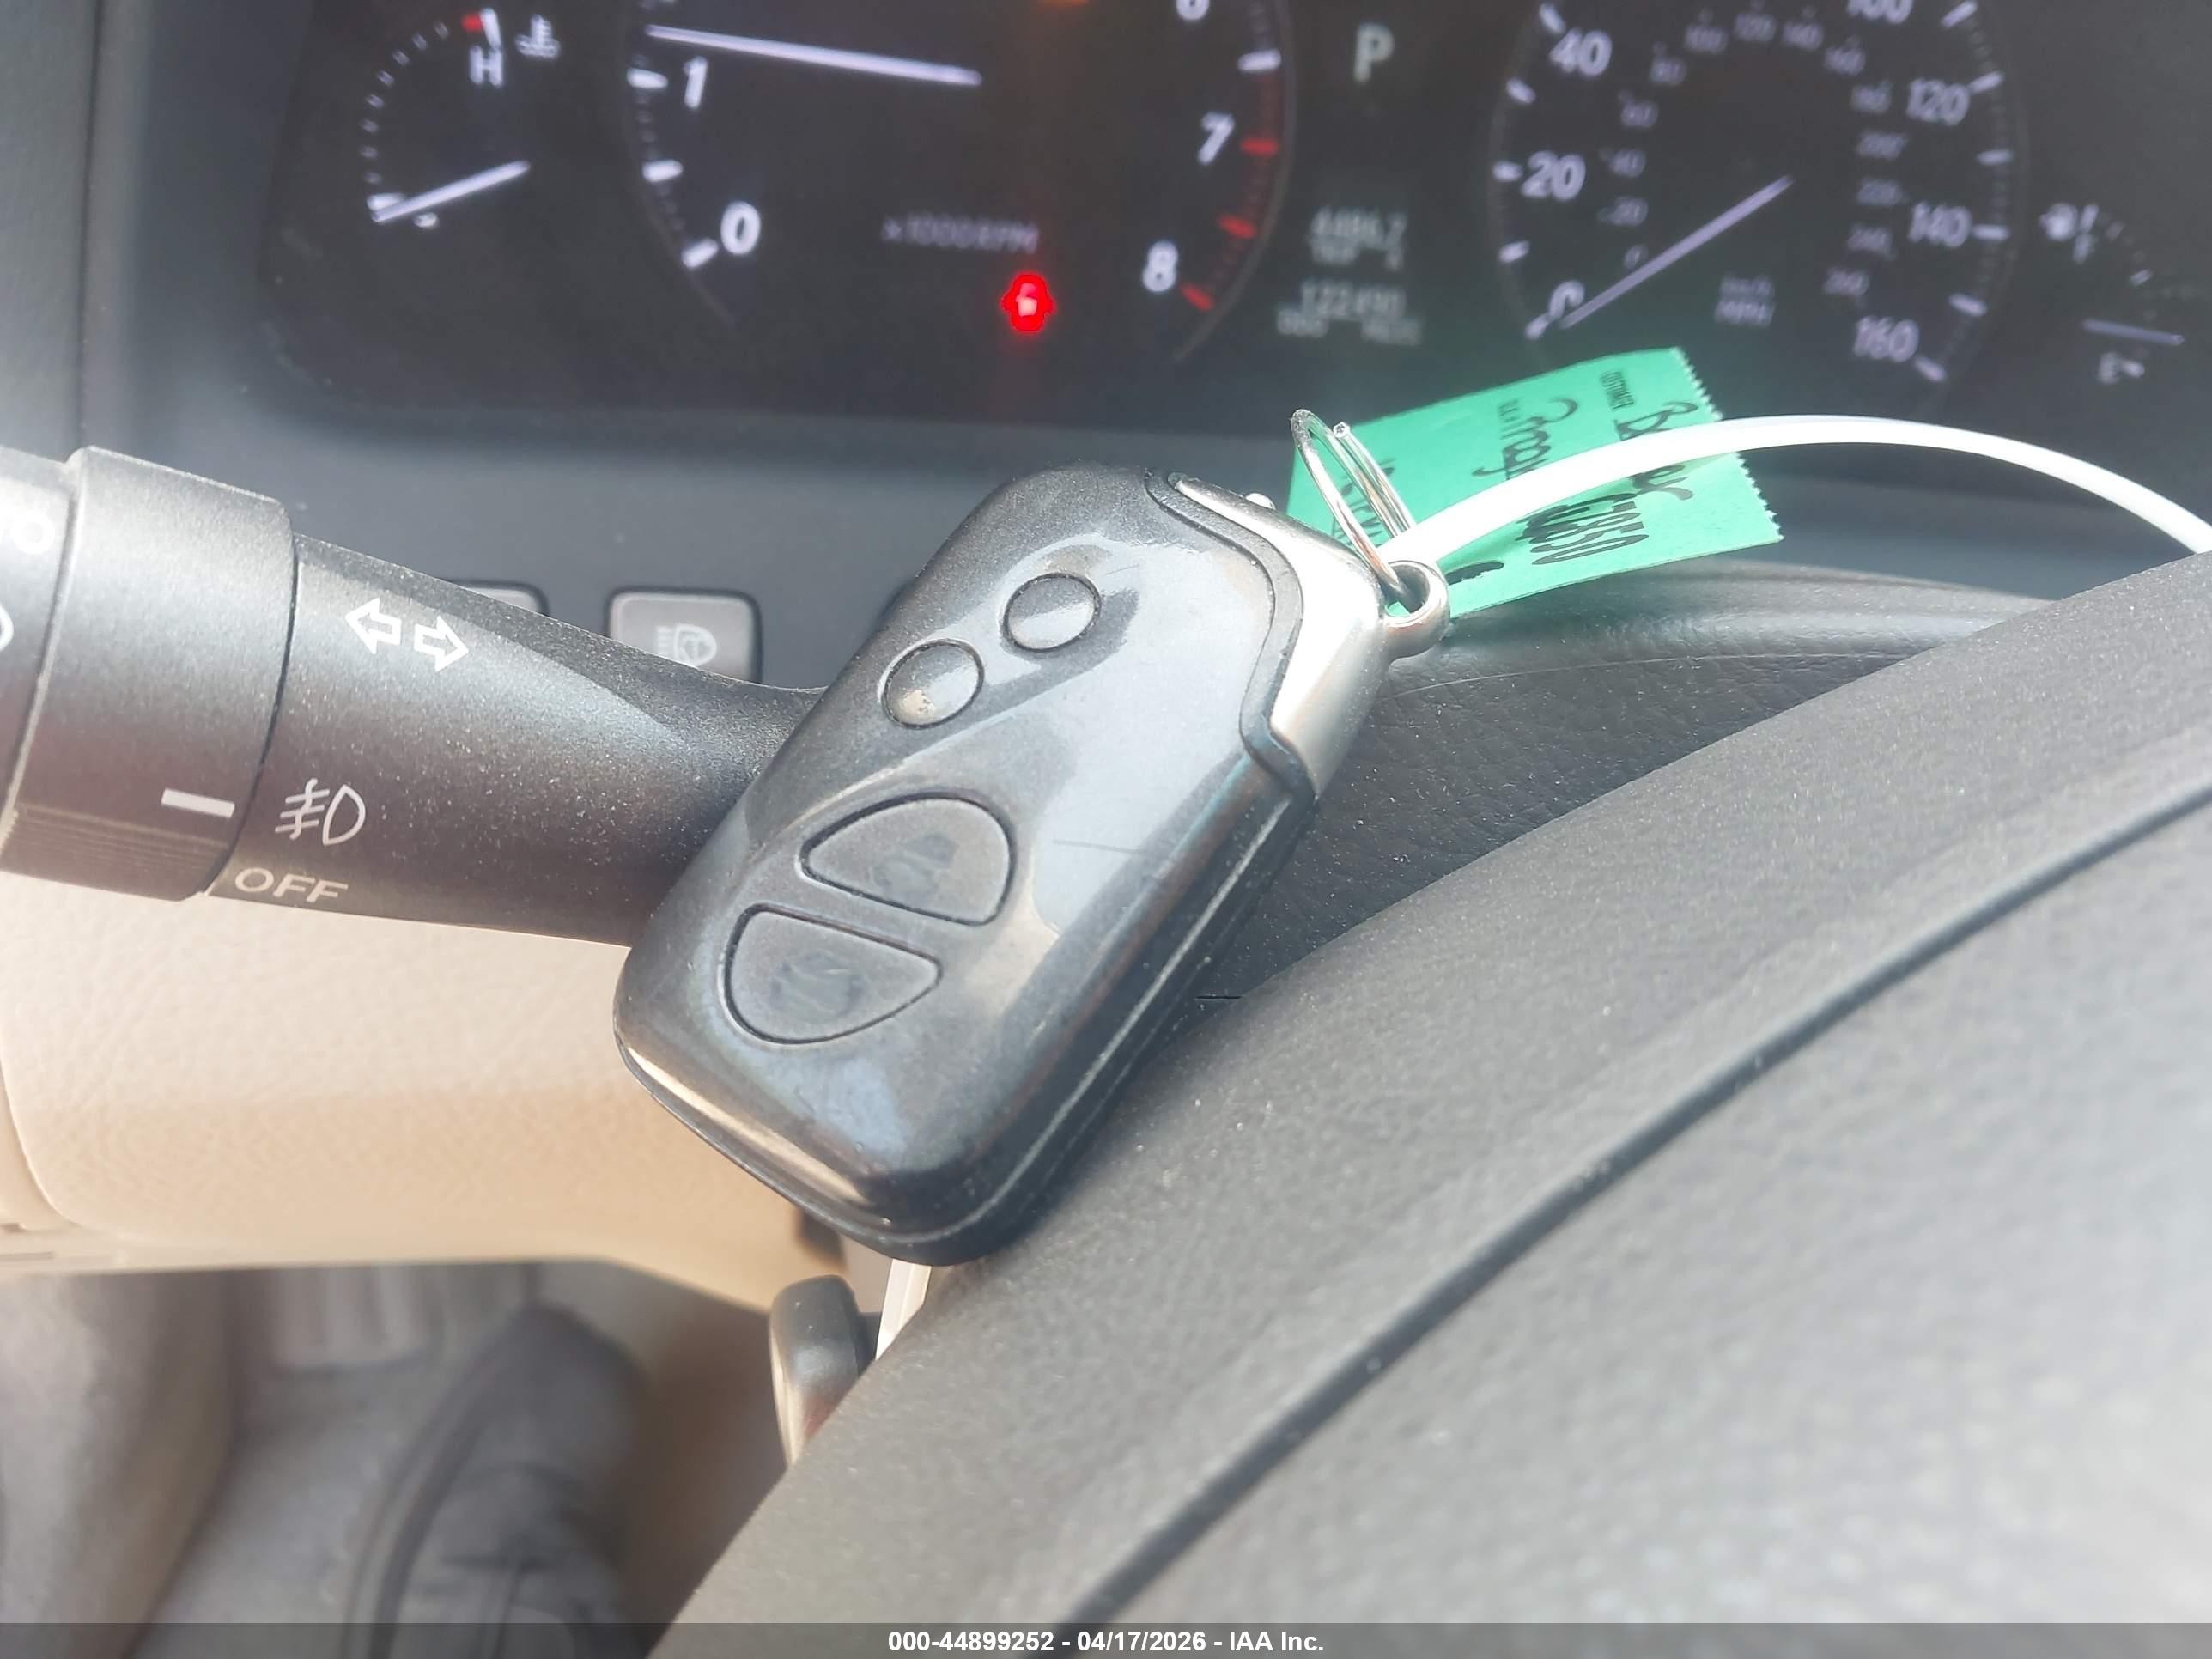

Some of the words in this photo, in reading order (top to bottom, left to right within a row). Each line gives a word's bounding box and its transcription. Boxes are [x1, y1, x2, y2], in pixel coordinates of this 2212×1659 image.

[470, 45, 503, 86] H
[1354, 24, 1394, 82] P
[1552, 29, 1612, 76] 40
[684, 57, 708, 109] 1
[1906, 78, 1970, 125] 120
[1199, 112, 1234, 165] 7
[1522, 150, 1586, 201] 20
[720, 201, 761, 255] 0
[1909, 202, 1972, 248] 140
[1142, 240, 1179, 293] 8
[1853, 316, 1920, 362] 160
[234, 867, 349, 904] OFF
